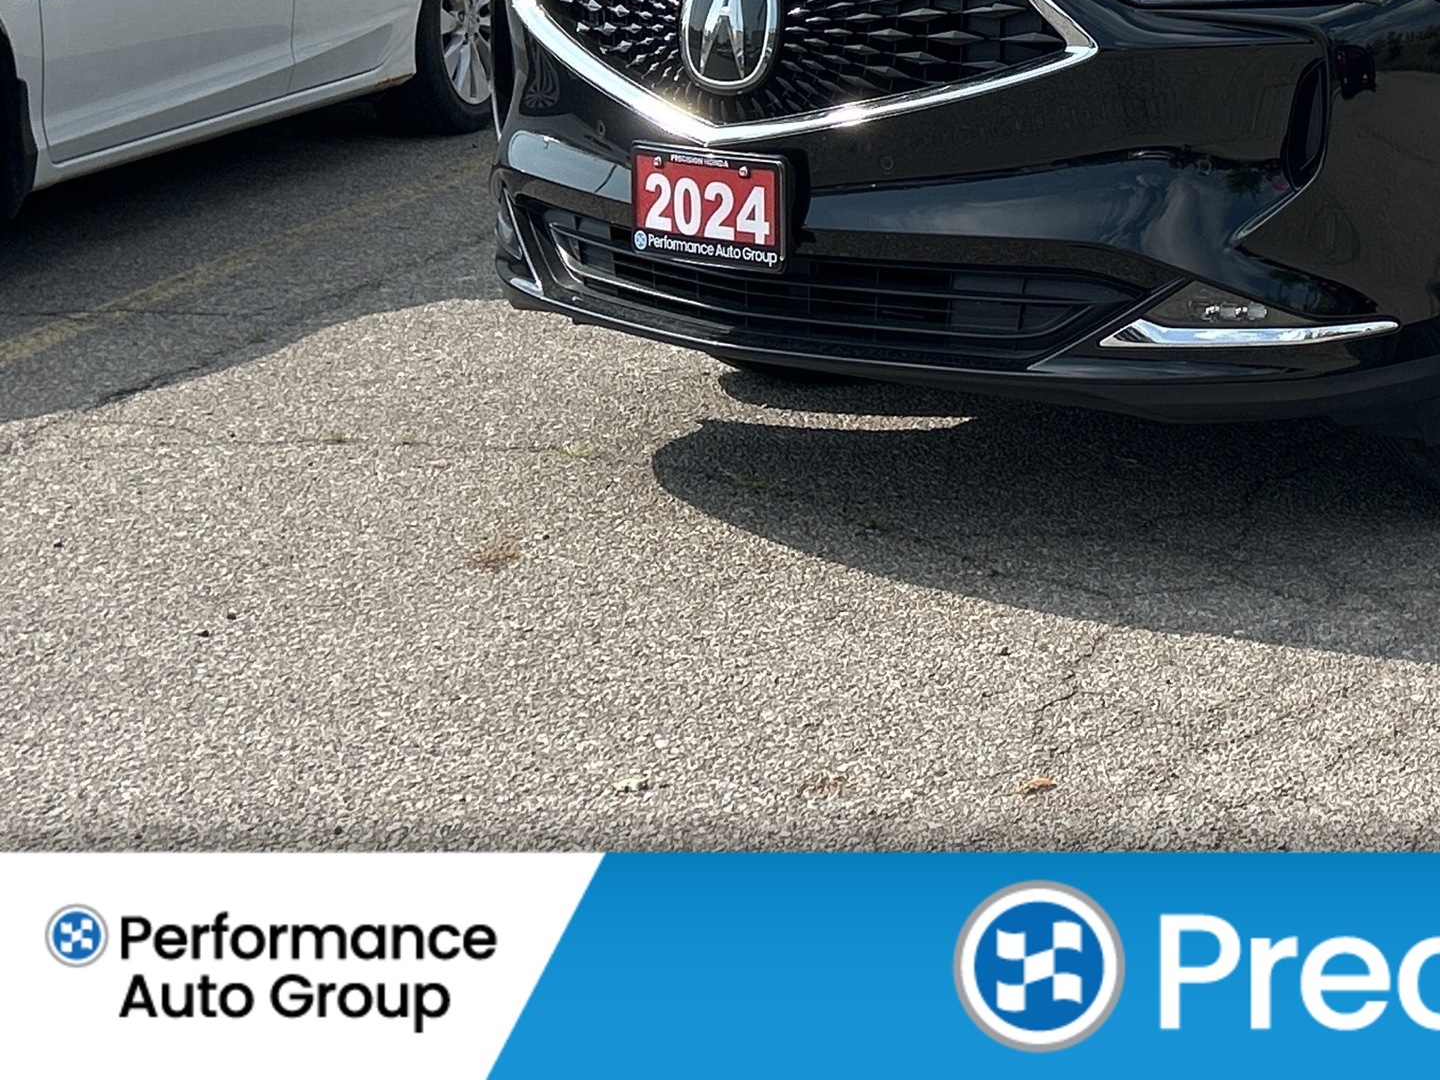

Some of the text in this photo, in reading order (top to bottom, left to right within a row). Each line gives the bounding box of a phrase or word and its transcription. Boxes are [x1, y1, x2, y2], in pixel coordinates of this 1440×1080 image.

[670, 153, 730, 169] PRECISION HONDA
[644, 172, 770, 246] 2024
[648, 233, 778, 268] Performance Auto Group
